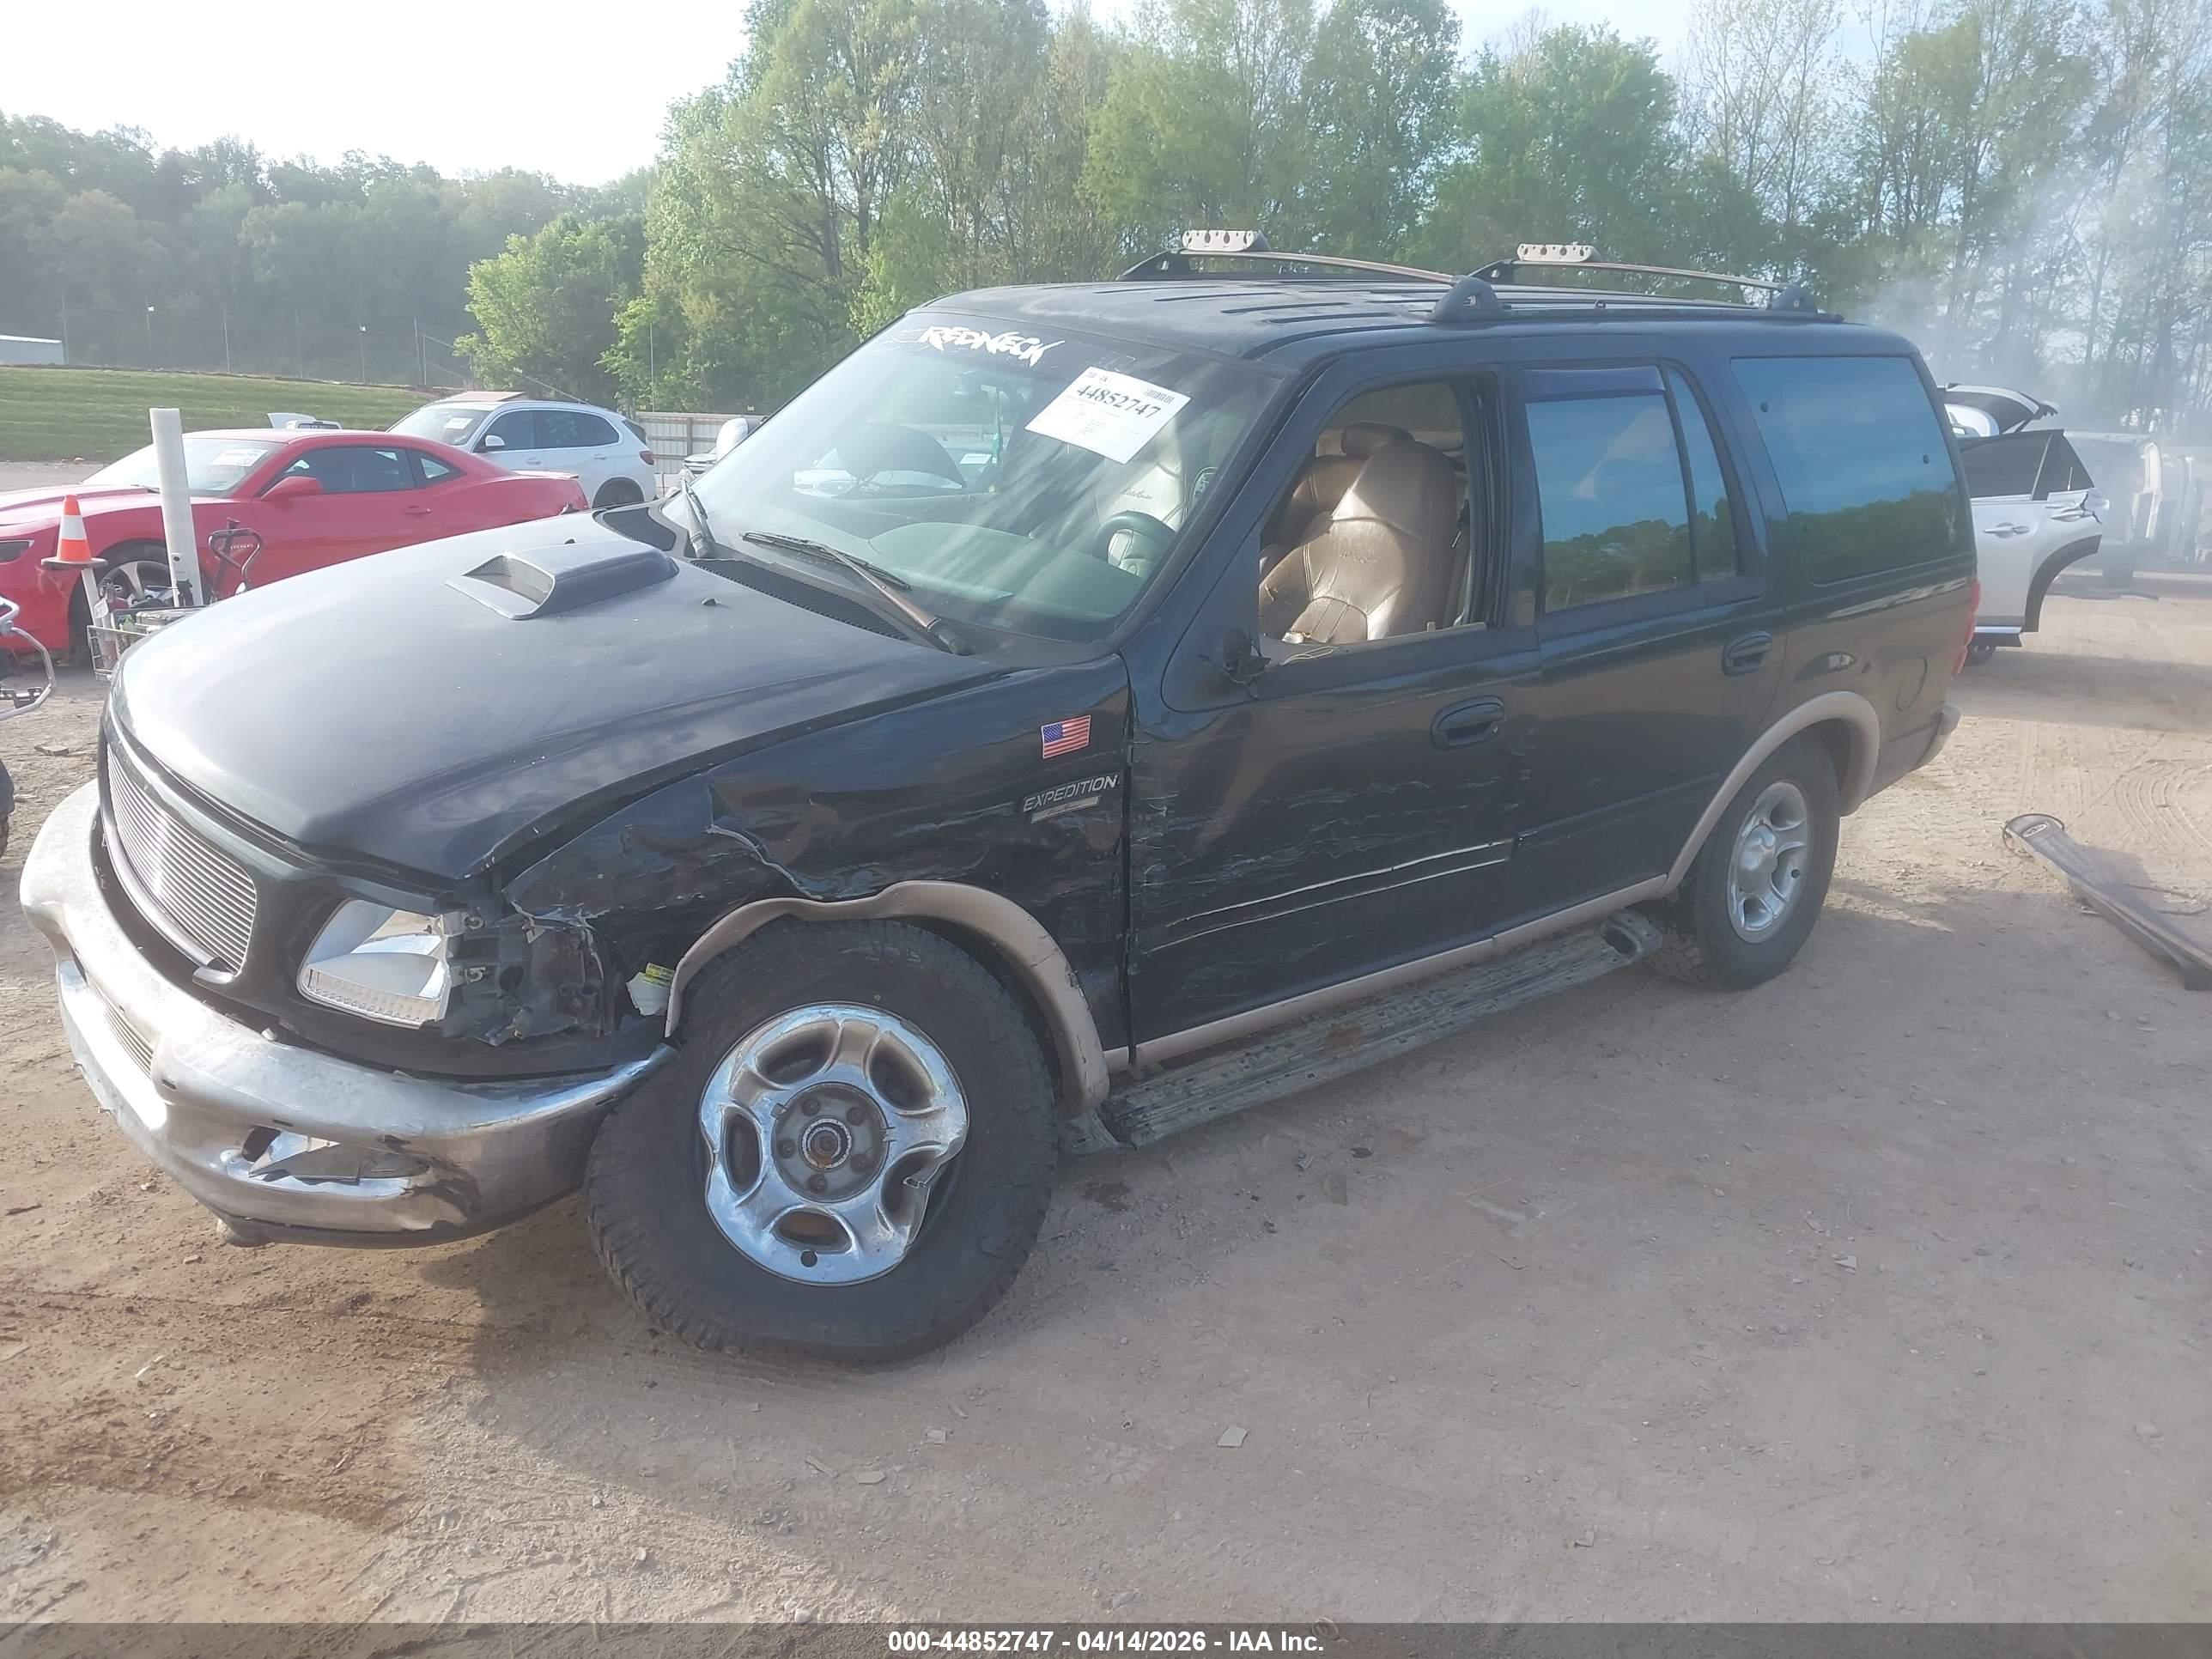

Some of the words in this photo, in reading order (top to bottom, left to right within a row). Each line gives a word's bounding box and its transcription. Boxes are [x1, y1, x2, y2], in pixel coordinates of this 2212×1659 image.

[916, 325, 1066, 368] REDNECK
[1076, 384, 1162, 418] 44852747
[1022, 774, 1118, 812] EXPEDITION
